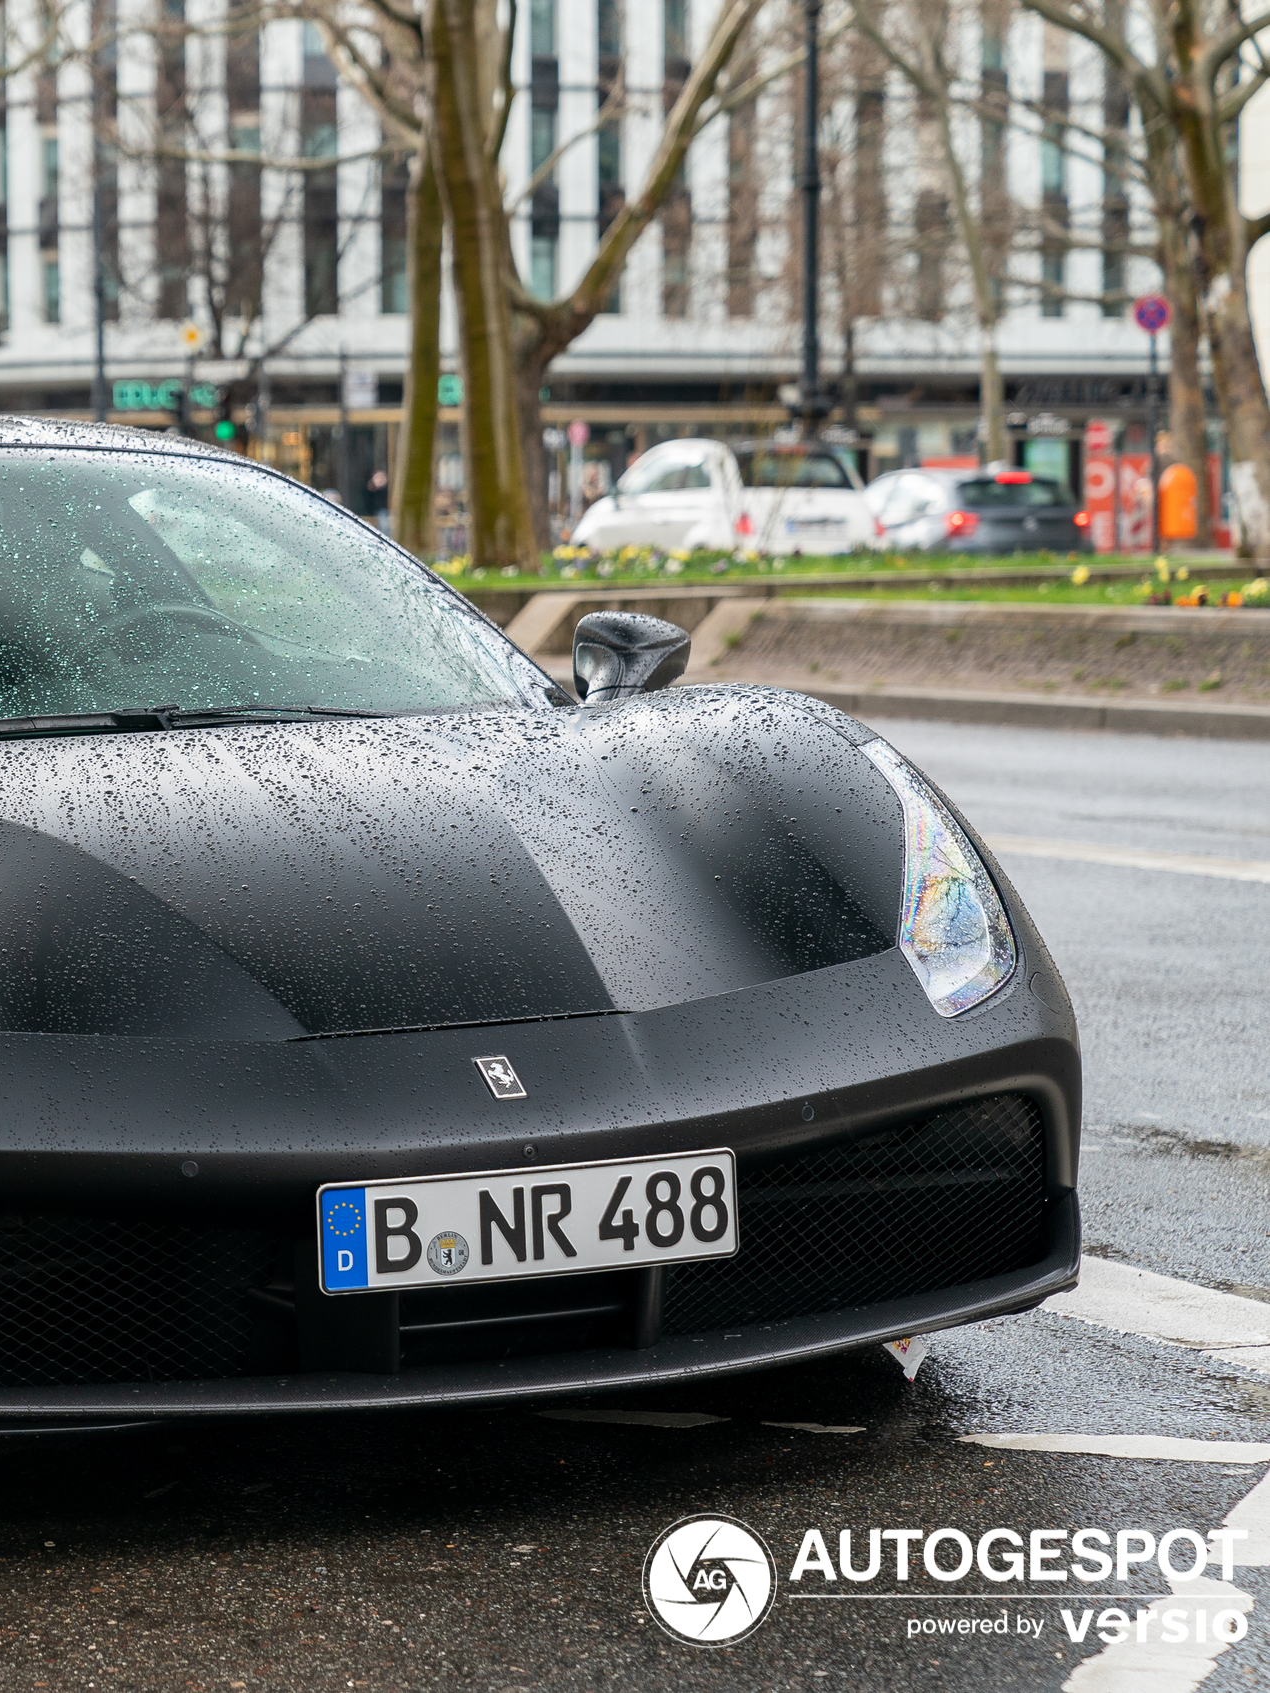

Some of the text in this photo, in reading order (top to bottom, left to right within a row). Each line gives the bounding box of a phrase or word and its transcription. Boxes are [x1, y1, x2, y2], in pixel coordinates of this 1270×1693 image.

[373, 1165, 730, 1274] B NR 488
[337, 1249, 354, 1272] D
